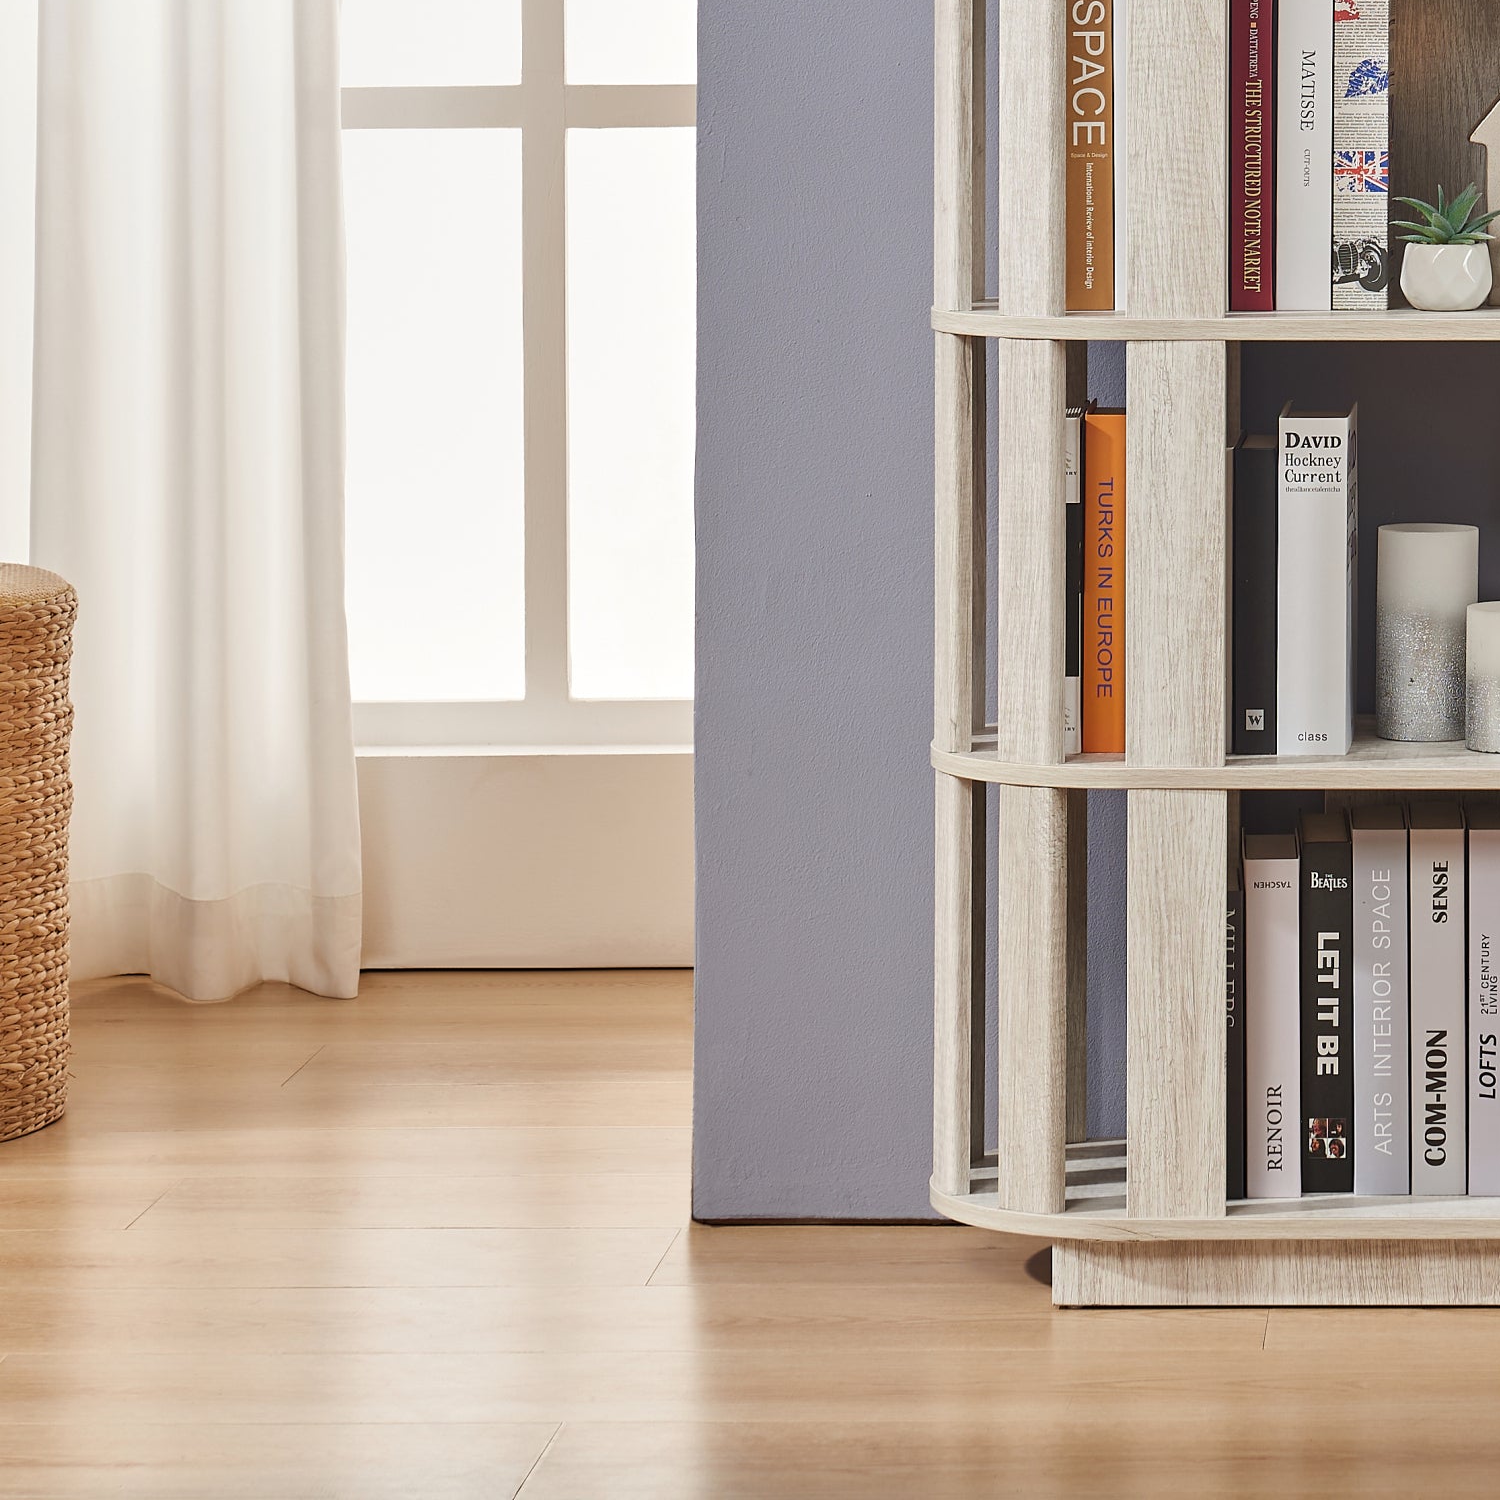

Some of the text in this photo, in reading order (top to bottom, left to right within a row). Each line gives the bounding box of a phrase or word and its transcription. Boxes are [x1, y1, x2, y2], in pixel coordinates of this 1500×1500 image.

[1072, 0, 1106, 146] SPACE
[1300, 50, 1316, 132] MATISSE
[1245, 80, 1263, 108] THE
[1244, 109, 1263, 197] STRUCTURED
[1303, 148, 1311, 187] CUT-OUTS
[1086, 162, 1094, 205] International
[1086, 207, 1094, 230] Review
[1243, 199, 1262, 238] NOTE
[1084, 266, 1094, 289] Design
[1285, 432, 1342, 448] DAVID
[1285, 453, 1342, 469] Hockney
[1285, 469, 1342, 483] Current
[1096, 477, 1114, 698] TURKS IN EUROPE
[1247, 715, 1262, 726] W
[1298, 731, 1328, 742] class
[1254, 881, 1292, 889] TASCHEN
[1311, 871, 1348, 891] BEATLES
[1432, 860, 1449, 923] SENSE
[1480, 934, 1491, 989] CENTURY
[1316, 932, 1340, 1076] LET IT BE
[1371, 869, 1393, 1156] ARTS INTERIOR SPACE
[1489, 975, 1498, 1015] LIVING
[1479, 1033, 1497, 1099] LOFTS
[1424, 1030, 1448, 1167] COM-MON
[1267, 1084, 1283, 1172] RENOIR
